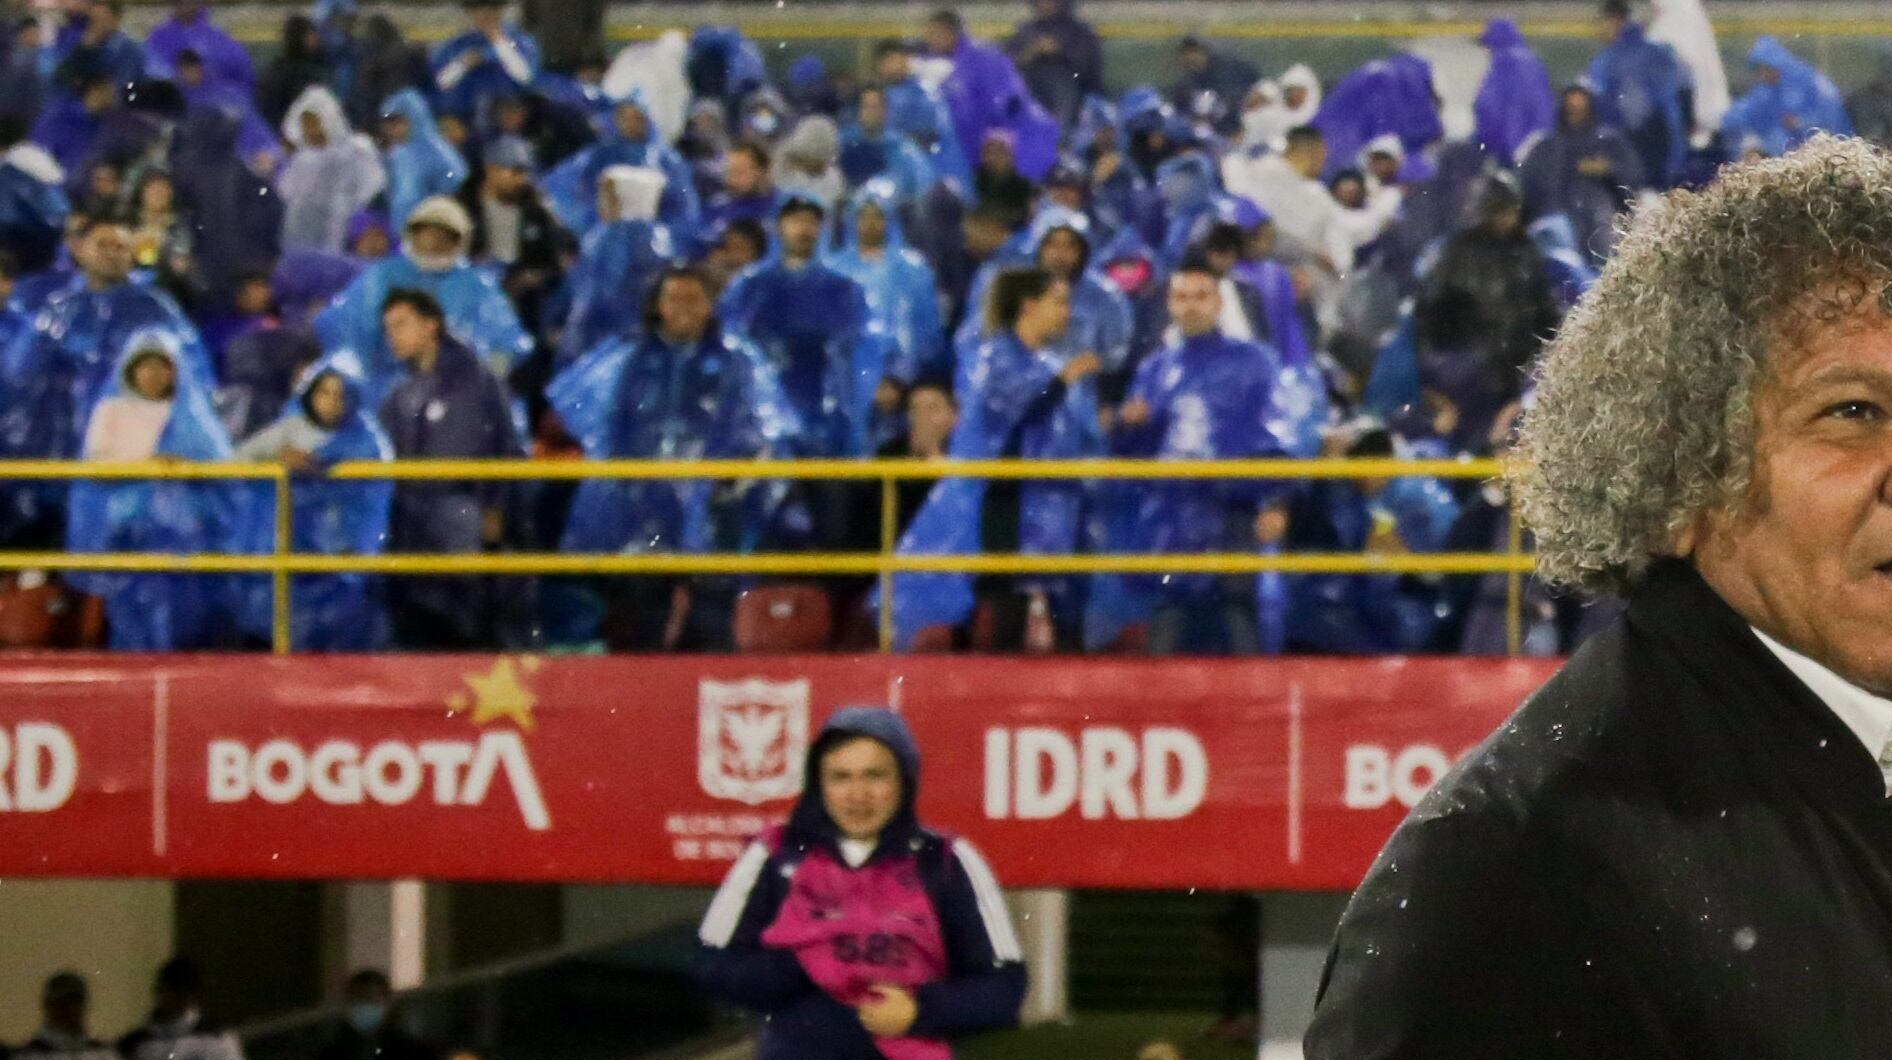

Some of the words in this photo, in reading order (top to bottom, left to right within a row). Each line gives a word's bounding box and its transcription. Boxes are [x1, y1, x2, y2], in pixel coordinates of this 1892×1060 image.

[0, 721, 79, 812] D
[984, 726, 1208, 820] IDRD
[1345, 744, 1449, 810] BO
